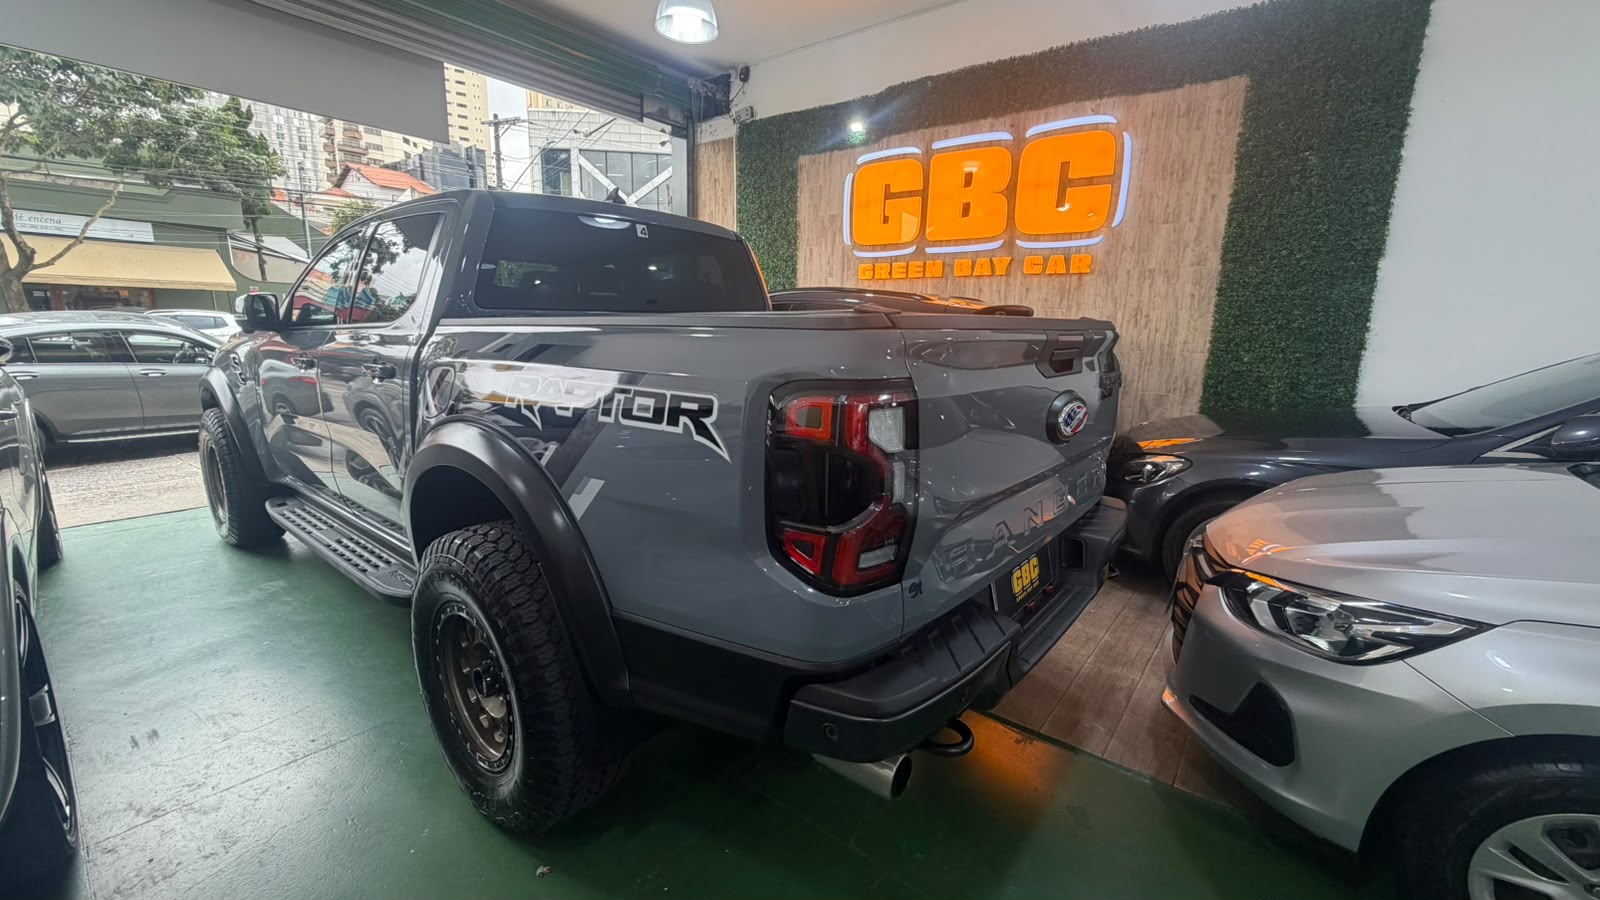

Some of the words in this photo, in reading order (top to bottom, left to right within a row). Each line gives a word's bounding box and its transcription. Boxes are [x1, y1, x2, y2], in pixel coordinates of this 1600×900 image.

[852, 130, 1117, 246] GBC
[858, 259, 944, 281] GREEN
[953, 256, 1012, 278] BAY
[1023, 253, 1093, 275] CAR
[505, 374, 732, 464] RAPTOR
[1012, 556, 1040, 594] GBC
